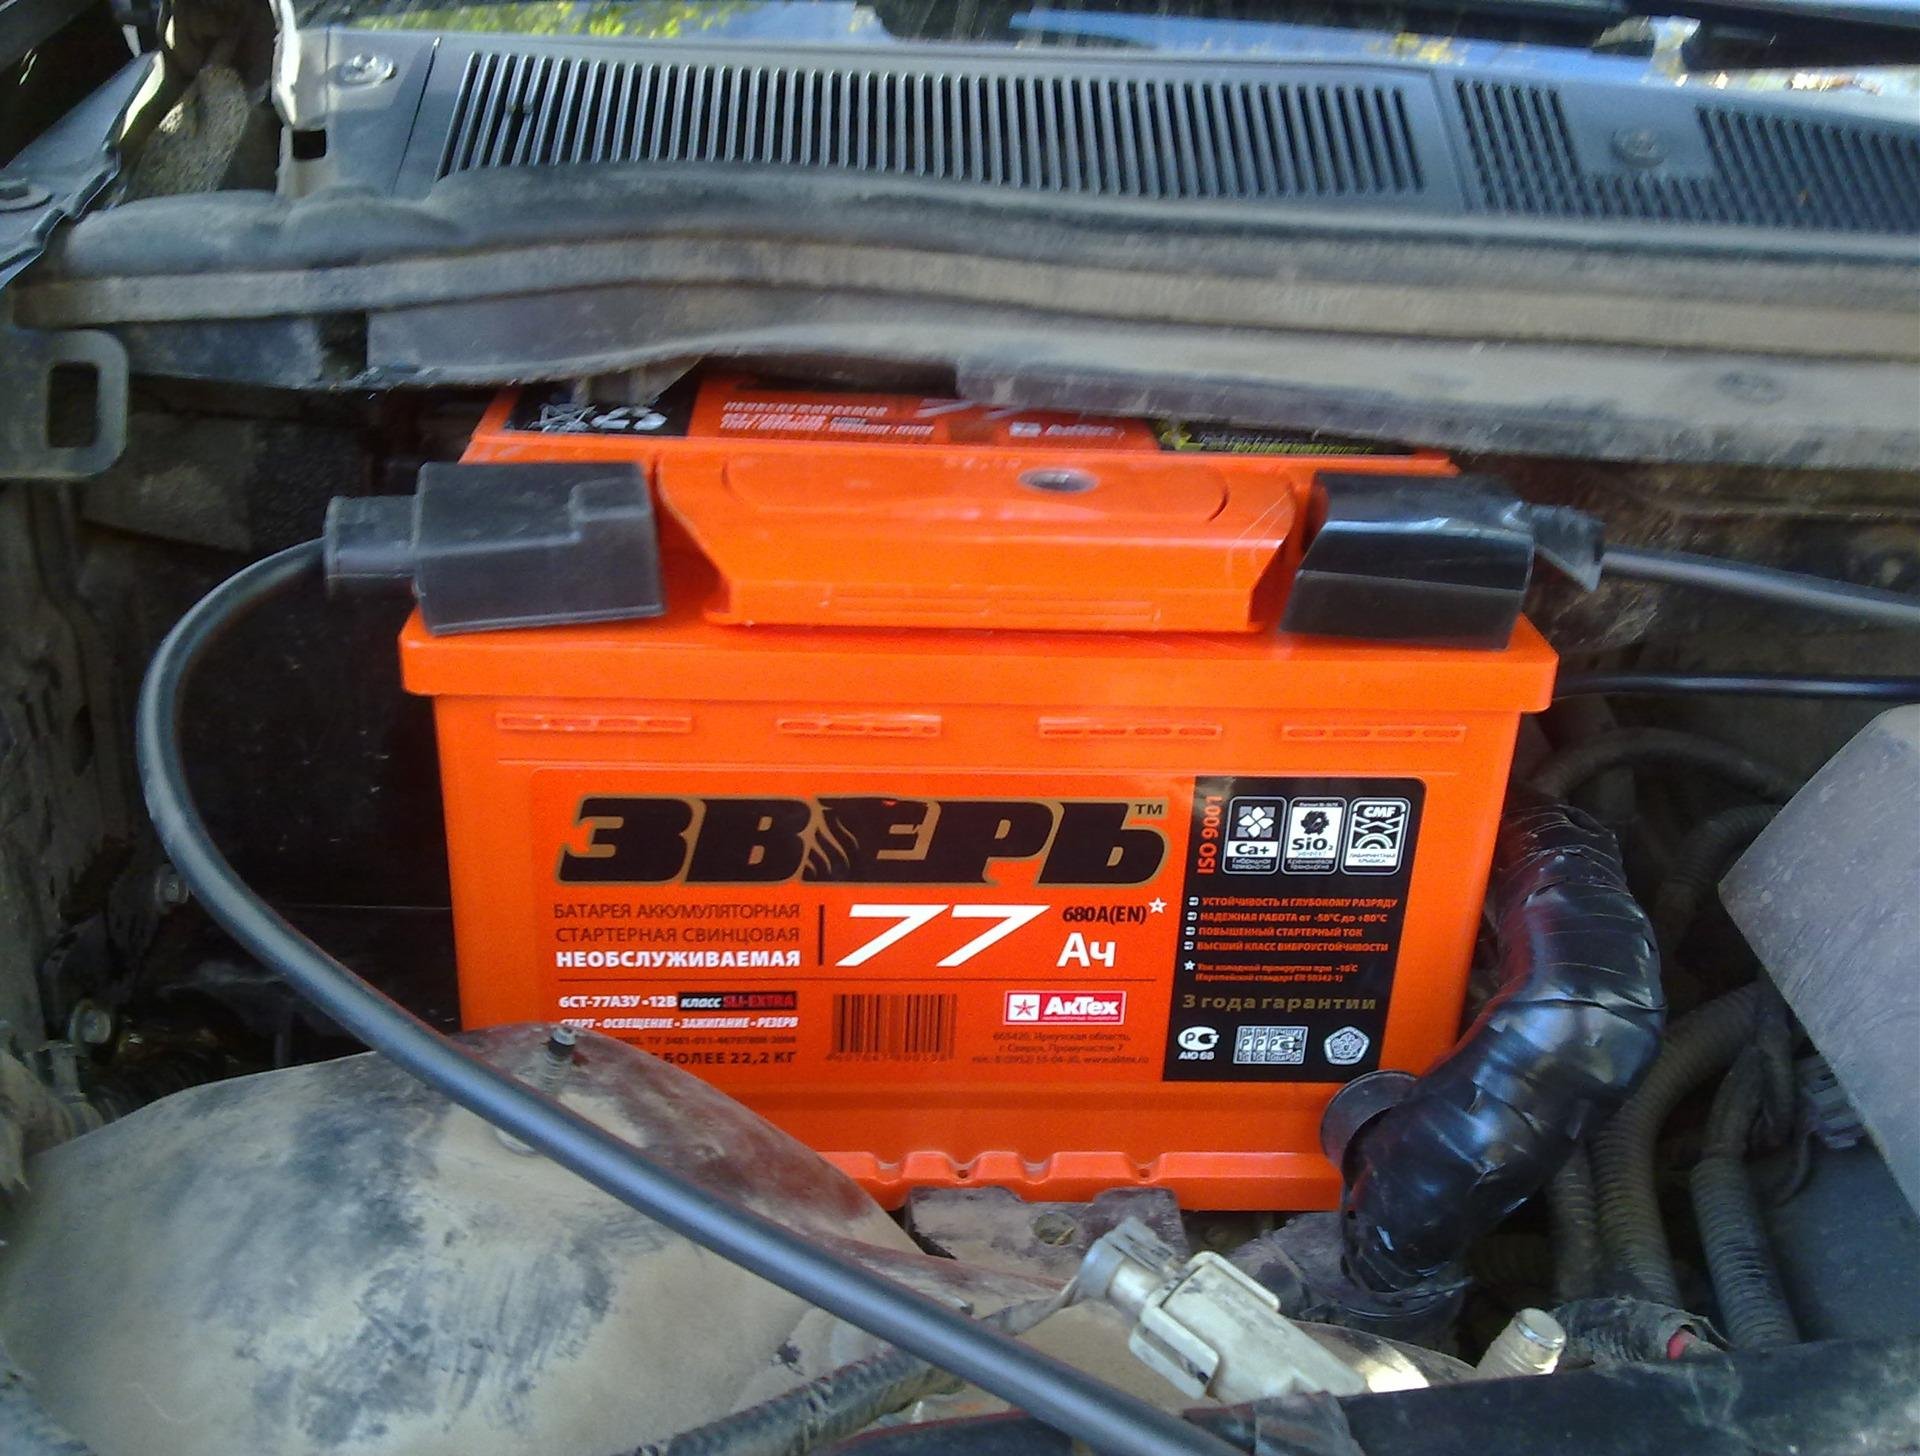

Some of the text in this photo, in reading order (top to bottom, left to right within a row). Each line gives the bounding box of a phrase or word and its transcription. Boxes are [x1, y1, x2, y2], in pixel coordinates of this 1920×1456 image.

[1363, 807, 1396, 817] CMF
[556, 796, 1167, 886] ЗВЕРЬ
[1197, 796, 1222, 874] ISO 9001
[1203, 897, 1280, 907] УСТОЙЧИВОСТЬ
[1352, 899, 1398, 909] РАЗРЯДУ
[554, 904, 800, 919] БАТАРЕЯ АККУМУЛЯТОРНАЯ
[1259, 913, 1298, 922] РАБОТА
[556, 928, 800, 946] СТАРТЕРНАЯ СВИНЦОВАЯ
[835, 904, 1050, 967] 77
[1199, 927, 1363, 937] ПОВЫШЕННЫЙ СТАРТЕРНЫЙ ТОК
[1056, 932, 1116, 967] Ач
[1197, 941, 1242, 951] ВЫСШИЙ
[1244, 942, 1276, 951] КЛАСС
[556, 951, 801, 968] НЕОБСЛУЖИВАЕМАЯ
[1043, 996, 1120, 1016] АкТех
[1182, 994, 1377, 1012] 3 года гарантии
[602, 1018, 675, 1030] ОСВЕЩЕНИЕ
[681, 1017, 751, 1029] ЗАЖИГАНИЕ
[756, 1016, 800, 1028] РЕЗЕРВ
[664, 1051, 797, 1065] БОЛЕЕ 22,2 КГ
